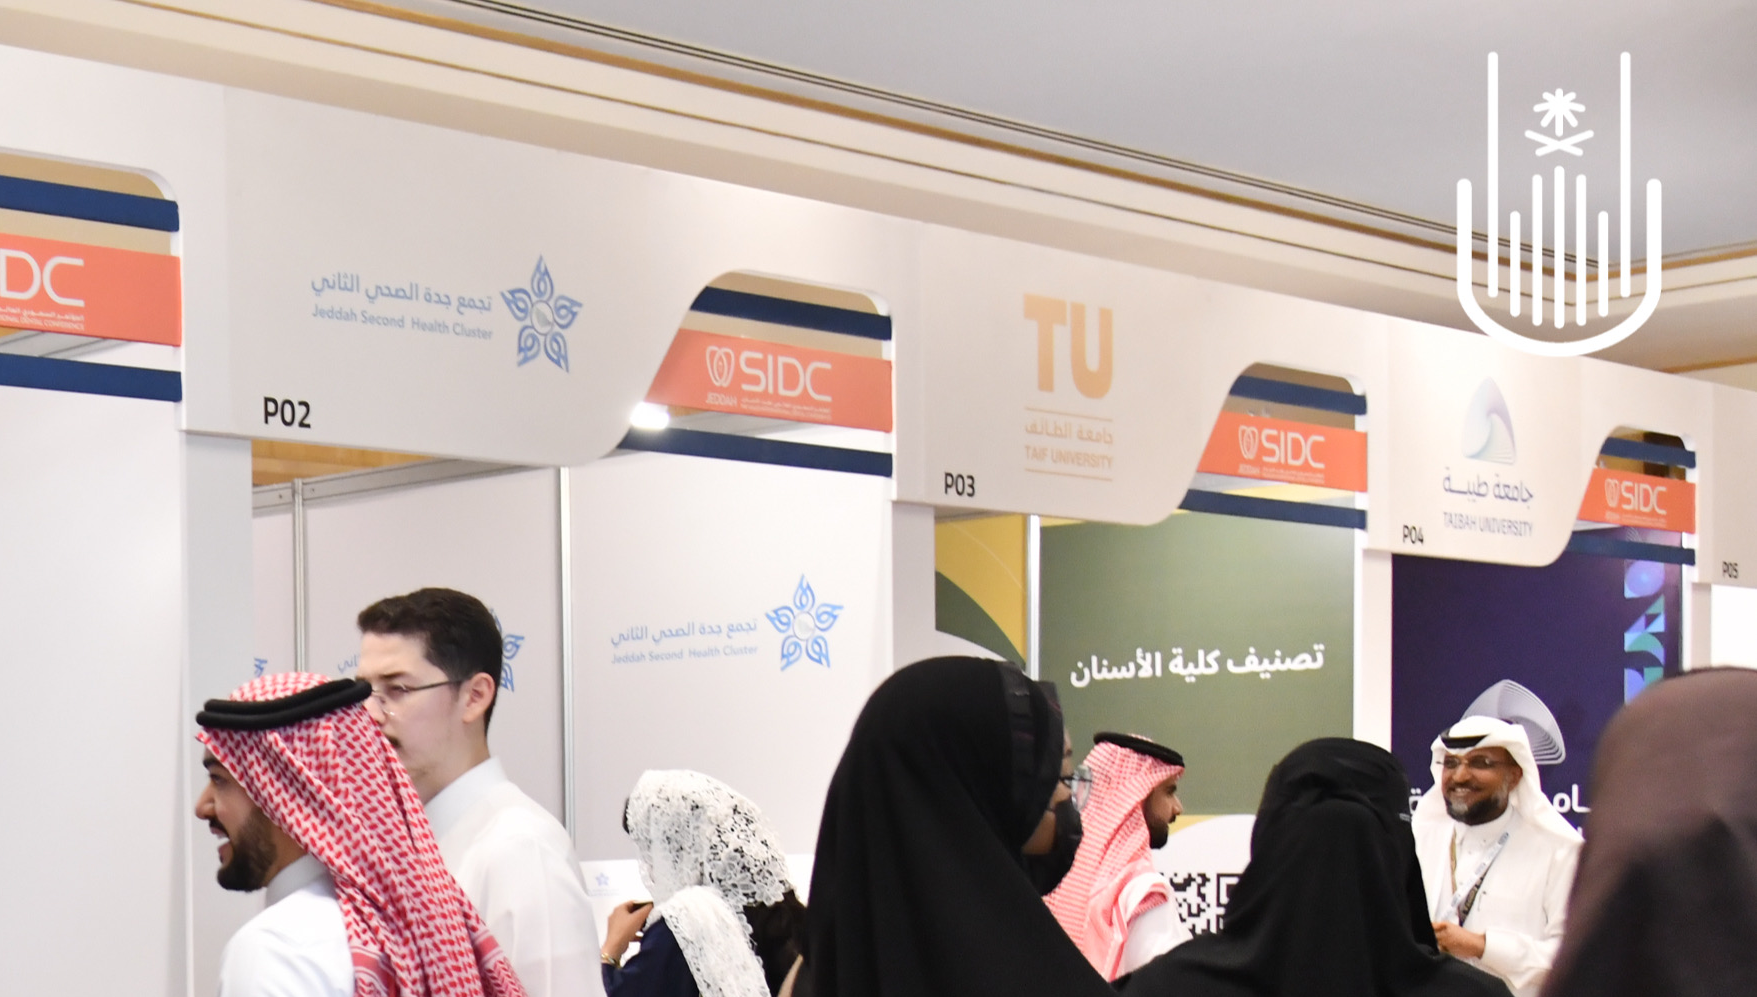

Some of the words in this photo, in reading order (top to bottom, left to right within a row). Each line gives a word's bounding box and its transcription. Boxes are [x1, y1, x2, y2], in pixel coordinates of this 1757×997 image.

[311, 272, 360, 297] الثاني
[365, 282, 419, 304] الصحي
[424, 287, 452, 310] جدة
[457, 295, 492, 315] تجمع
[312, 304, 358, 322] Jeddah
[361, 310, 405, 328] Second
[411, 317, 450, 334] Health
[452, 322, 493, 340] Cluster
[1023, 292, 1114, 400] TU
[739, 351, 832, 402] SIDC
[263, 396, 311, 429] P02
[1077, 423, 1114, 445] جامعة
[1025, 445, 1048, 462] TAIF
[1051, 448, 1114, 469] UNIVERSITY
[1261, 429, 1325, 469] SIDC
[944, 472, 976, 498] P03
[1443, 466, 1489, 503] طيبة
[1493, 473, 1533, 510] جامعة
[1621, 481, 1667, 515] SIDC
[1403, 524, 1424, 545] P04
[1443, 511, 1477, 531] TAIBAH
[1479, 516, 1533, 537] UNIVERSITY
[1722, 561, 1739, 579] P05
[611, 652, 646, 665] Jeddah
[649, 648, 684, 662] Second
[688, 645, 720, 659] Health
[723, 644, 758, 657] Cluster
[1070, 647, 1163, 688] الأسنان
[1168, 646, 1221, 683] كلية
[1226, 643, 1326, 680] تصنيف
